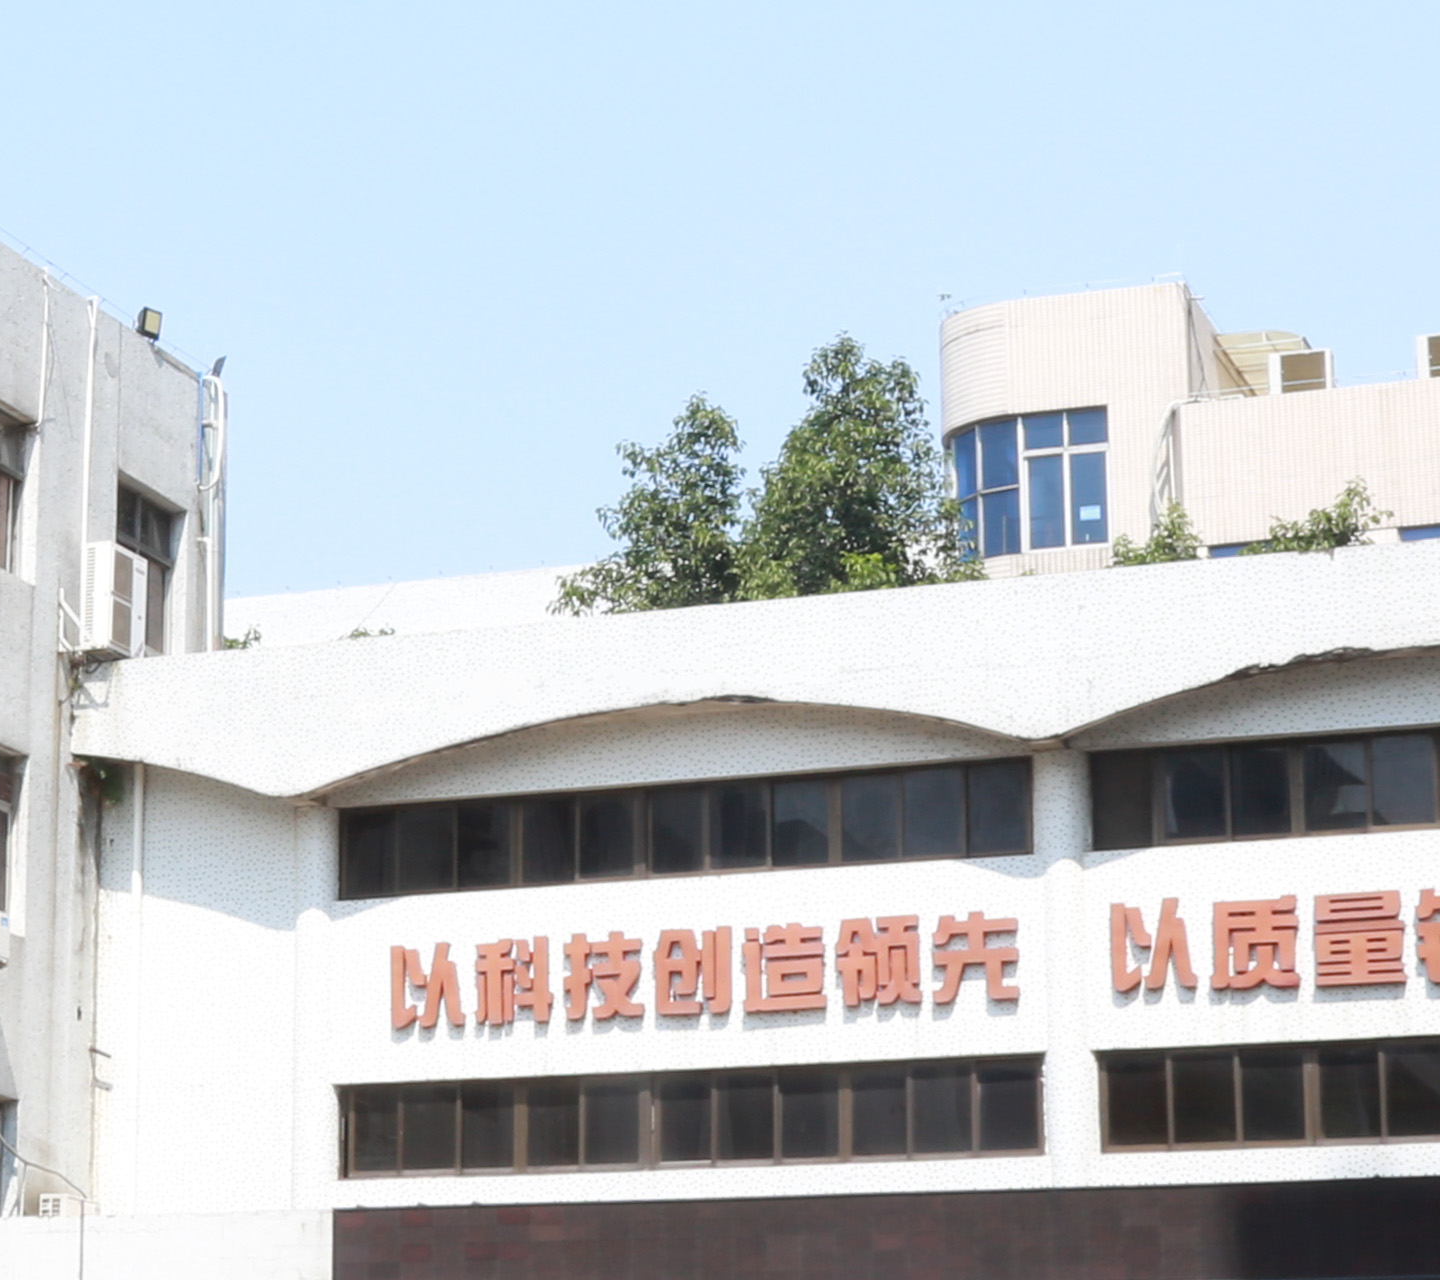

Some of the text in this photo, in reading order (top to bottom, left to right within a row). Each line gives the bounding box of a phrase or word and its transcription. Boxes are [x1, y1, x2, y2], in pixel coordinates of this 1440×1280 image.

[389, 910, 1020, 1030] 以科技创造领先
